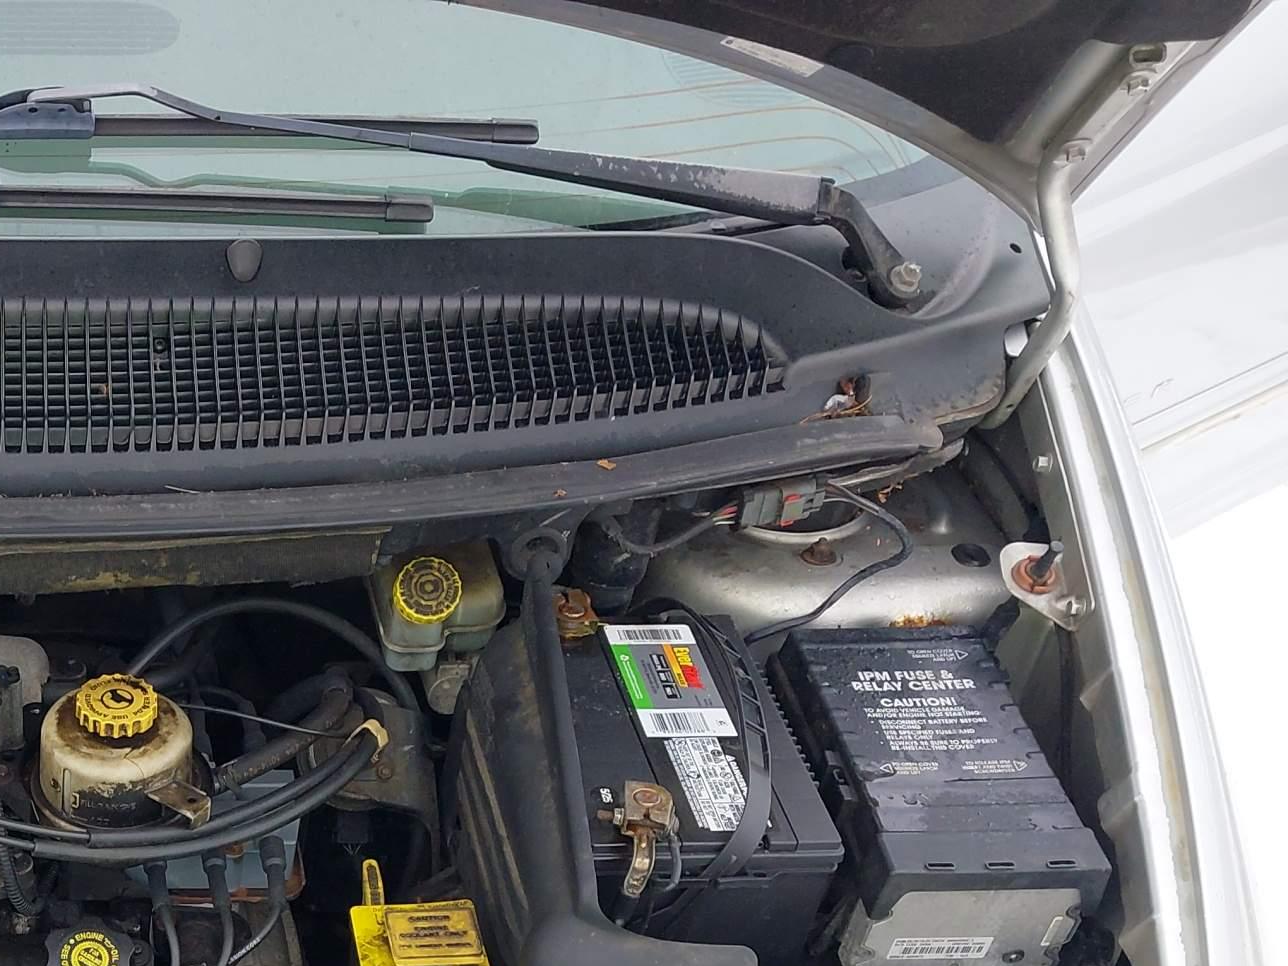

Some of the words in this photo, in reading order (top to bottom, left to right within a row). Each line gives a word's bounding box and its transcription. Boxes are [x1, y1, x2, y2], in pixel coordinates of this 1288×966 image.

[857, 671, 892, 681] IPM
[894, 671, 935, 681] FUSE
[941, 670, 954, 680] &
[851, 681, 903, 691] RELAY
[908, 679, 976, 691] CENTER
[880, 698, 958, 707] CAUTION!
[60, 943, 71, 960] SEE
[74, 931, 105, 942] ENGINE
[110, 949, 119, 963] OIL
